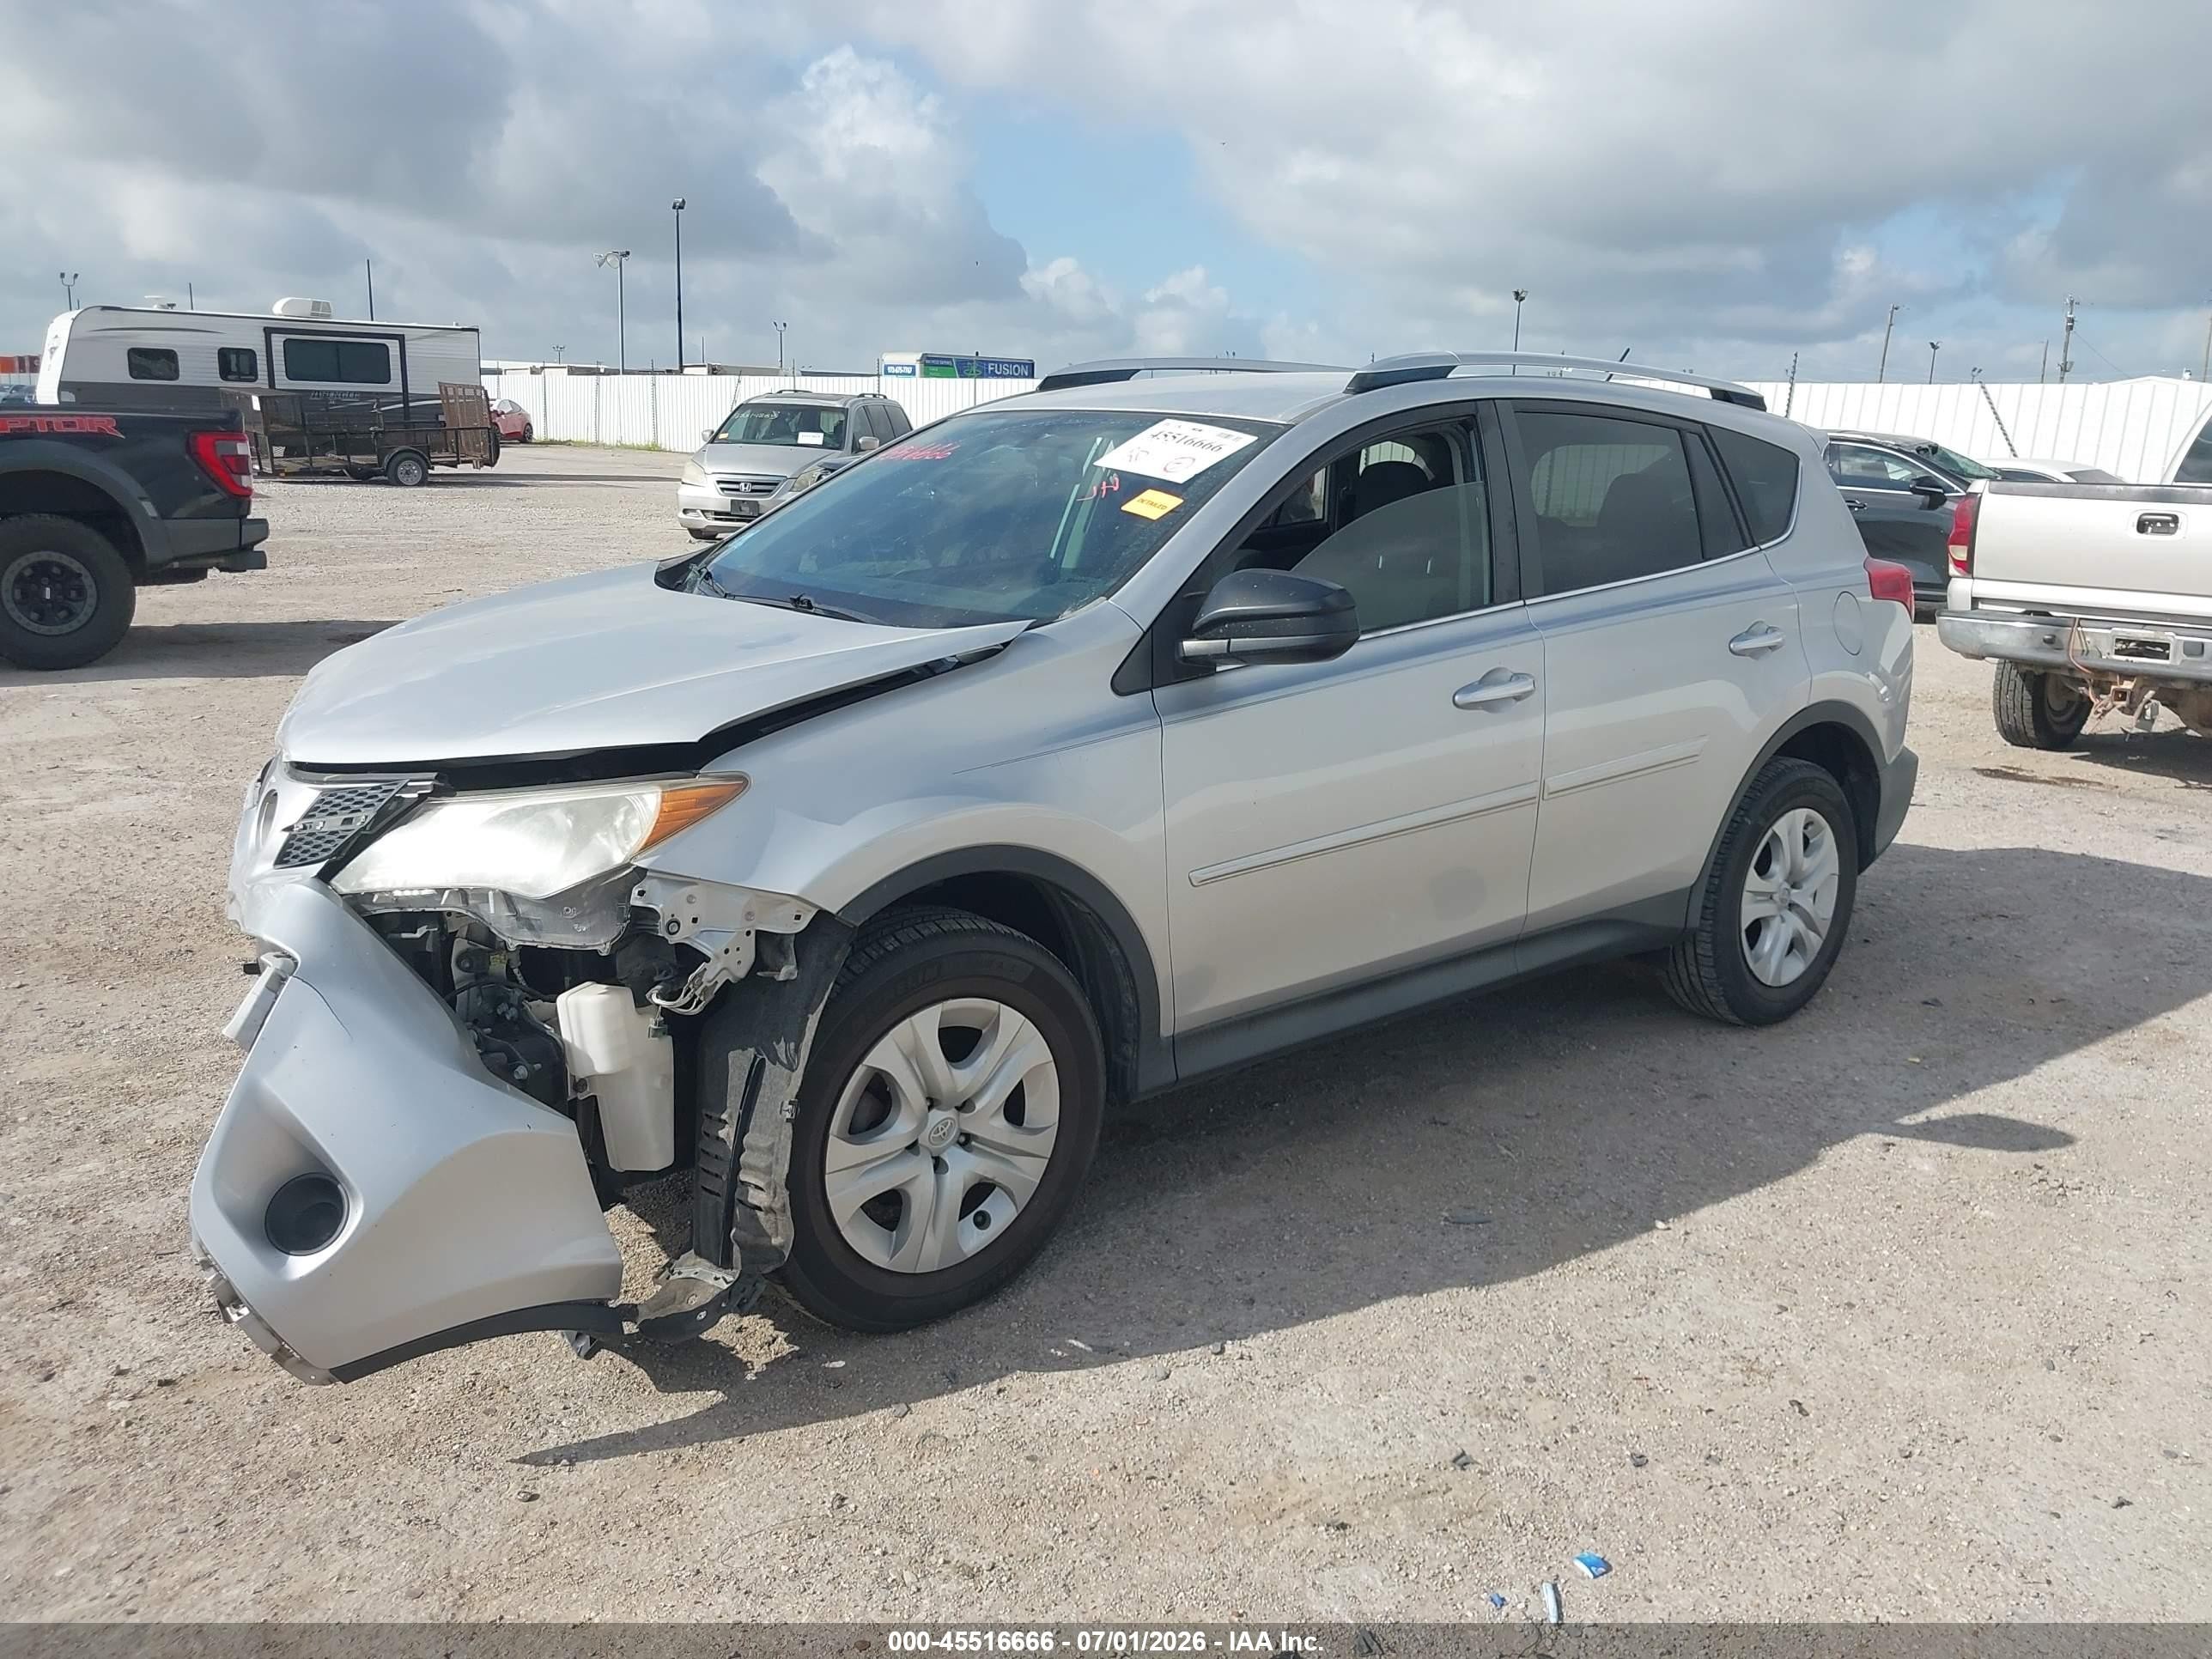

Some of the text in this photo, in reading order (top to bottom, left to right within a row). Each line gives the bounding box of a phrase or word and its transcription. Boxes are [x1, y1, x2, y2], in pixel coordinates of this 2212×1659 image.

[988, 362, 1029, 377] FUSION
[1152, 430, 1224, 453] 45516666
[1137, 498, 1168, 510] DETAILED
